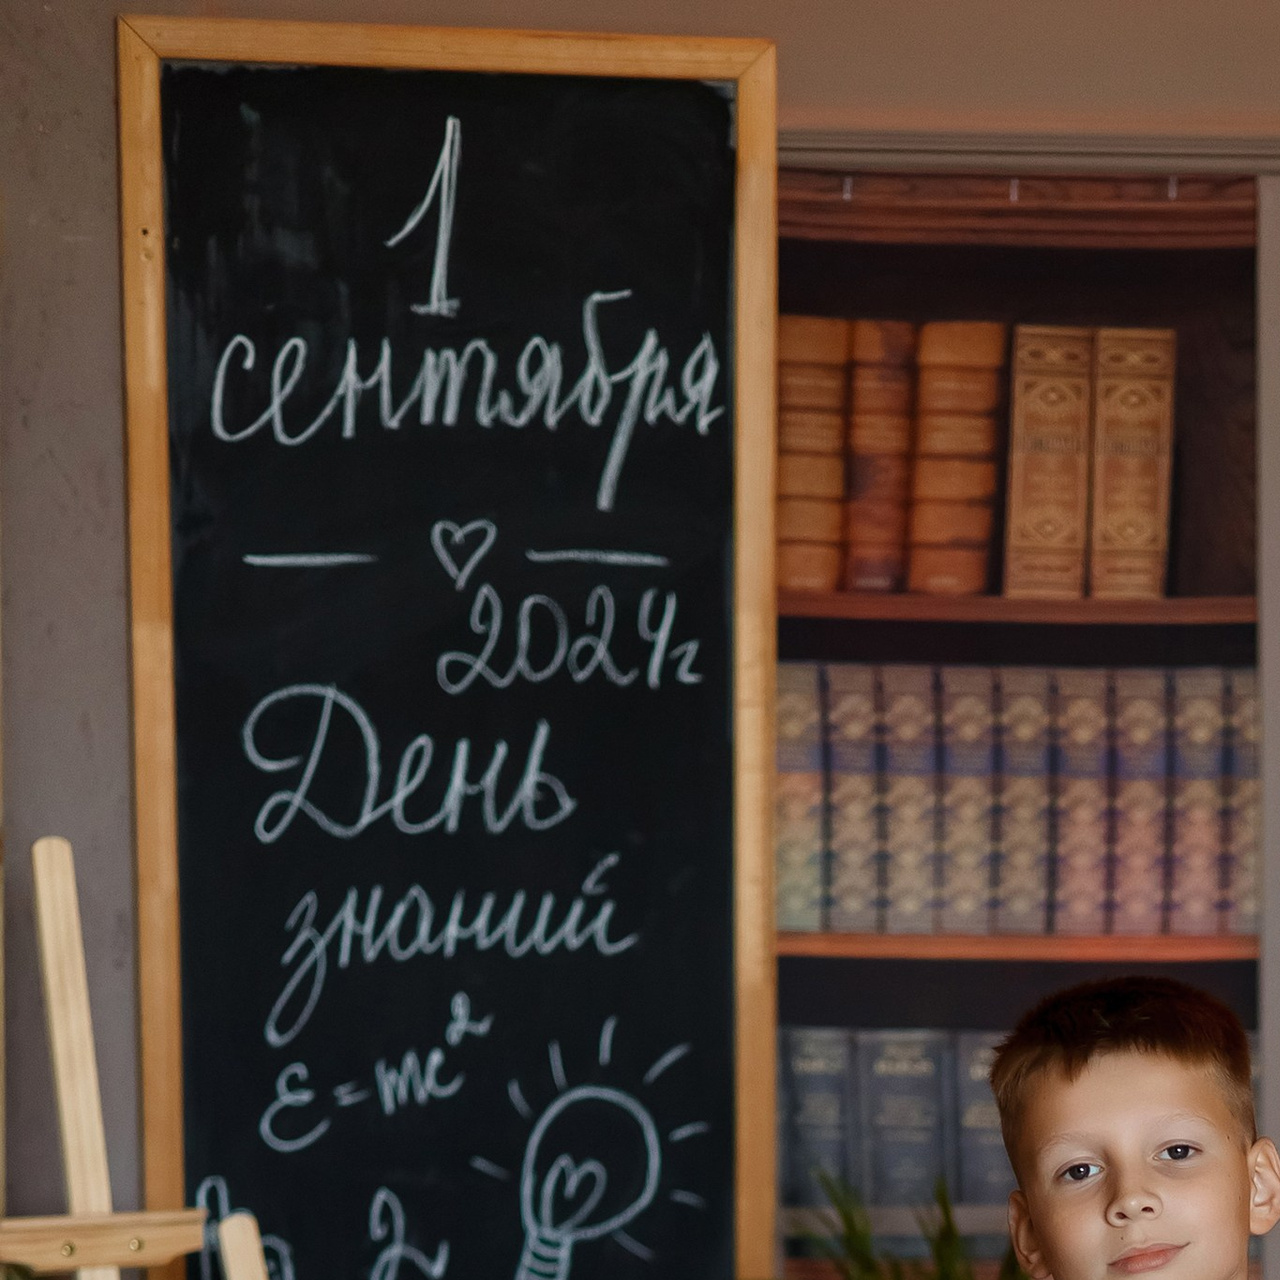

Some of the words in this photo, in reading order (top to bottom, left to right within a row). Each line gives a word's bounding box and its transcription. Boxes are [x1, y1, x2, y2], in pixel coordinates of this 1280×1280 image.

[385, 115, 461, 317] 1
[210, 290, 725, 511] сентября
[242, 682, 578, 844] День
[263, 853, 640, 1047] знаний
